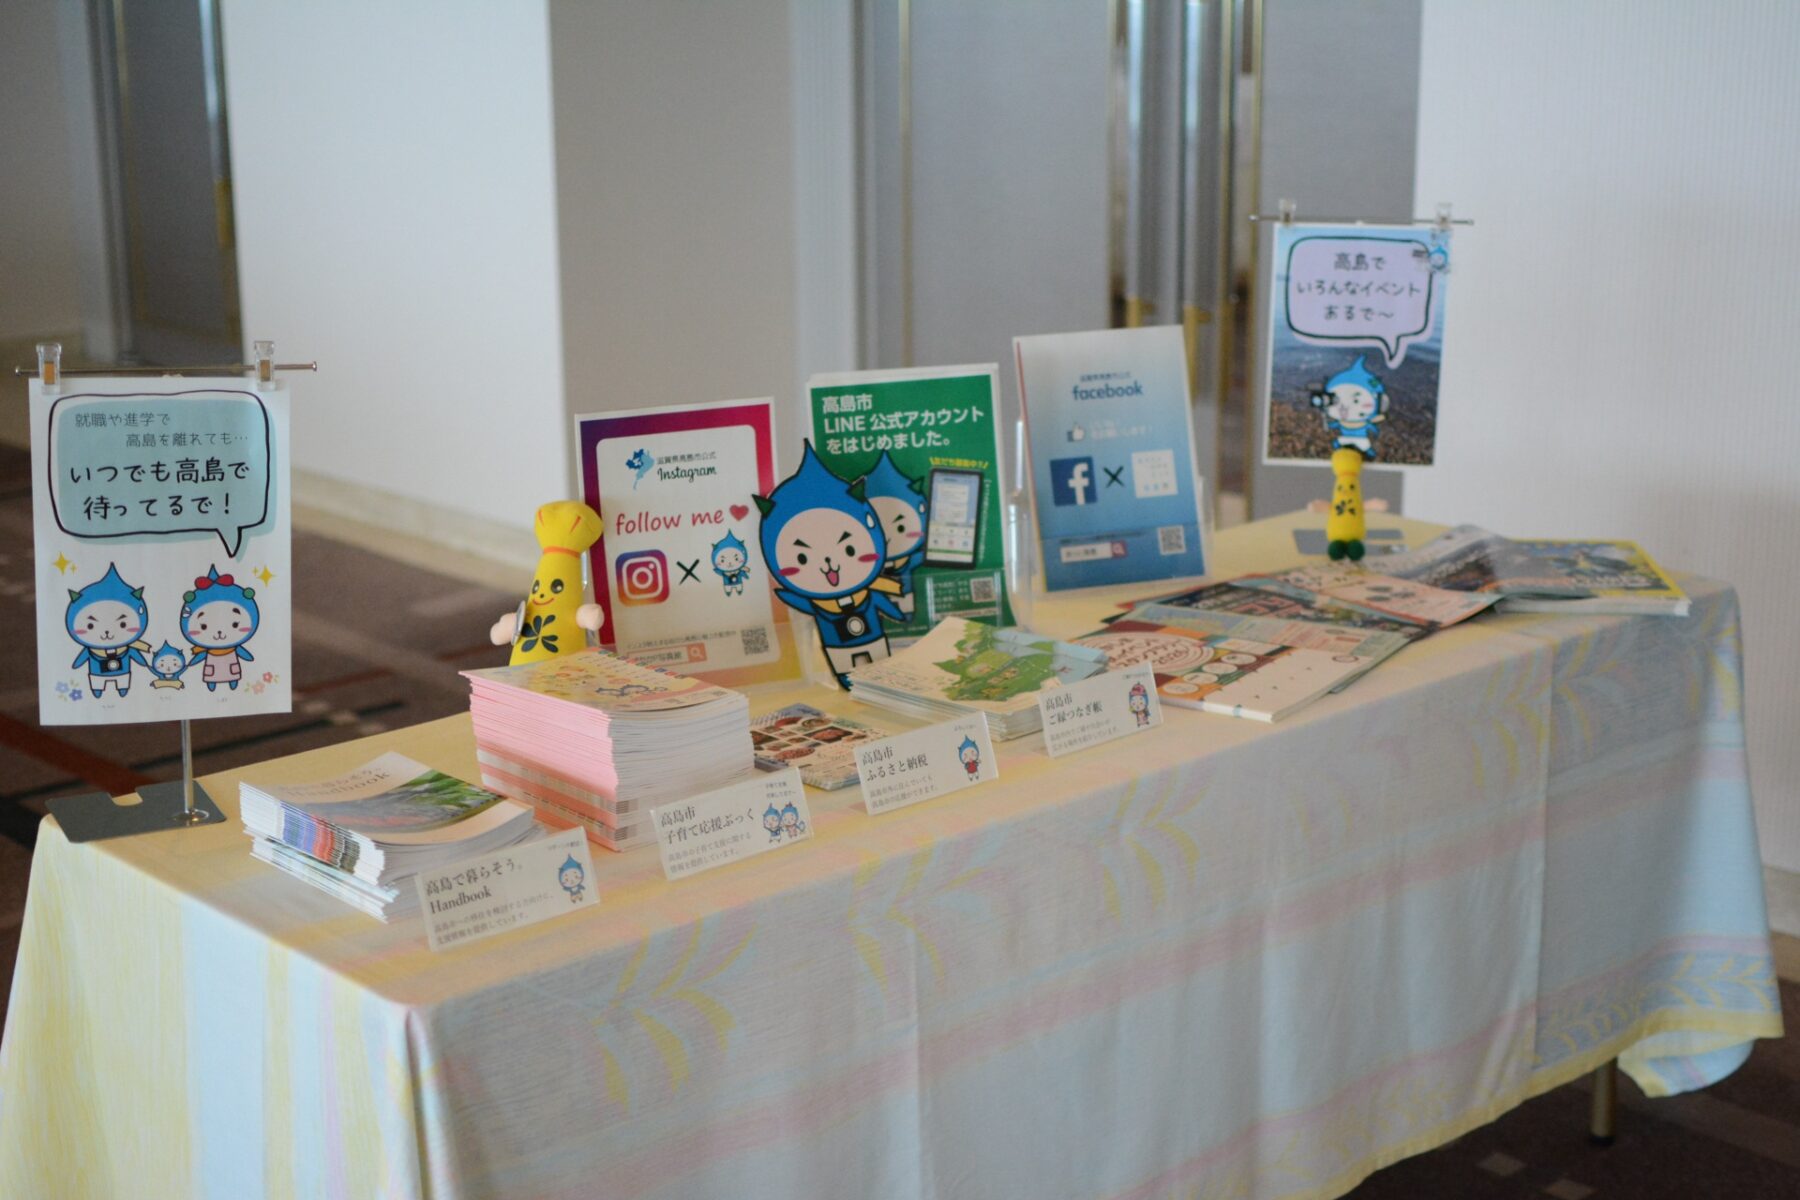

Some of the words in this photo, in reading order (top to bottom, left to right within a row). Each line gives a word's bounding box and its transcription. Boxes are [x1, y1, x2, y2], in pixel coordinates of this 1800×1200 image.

[1333, 252, 1388, 272] 高島で
[1296, 279, 1421, 297] いろんなイベント
[1071, 380, 1144, 401] facebook
[821, 393, 873, 414] 高島市
[75, 412, 171, 428] 就職や進学で
[823, 415, 867, 434] LINE
[869, 405, 985, 432] 公式アカウント
[826, 430, 951, 455] をはじめました。
[70, 456, 250, 484] いつでも高島で
[656, 465, 717, 484] Instagram
[615, 510, 682, 536] follow
[691, 509, 725, 527] me
[1045, 692, 1073, 712] 高島市
[861, 745, 894, 766] 高島市
[866, 753, 929, 782] ふるさと納税
[660, 805, 697, 828] 高島市
[664, 807, 755, 845] 子育て応援ぶっく
[425, 857, 524, 897] 高島で暮らそう。
[429, 884, 493, 915] Handbook
